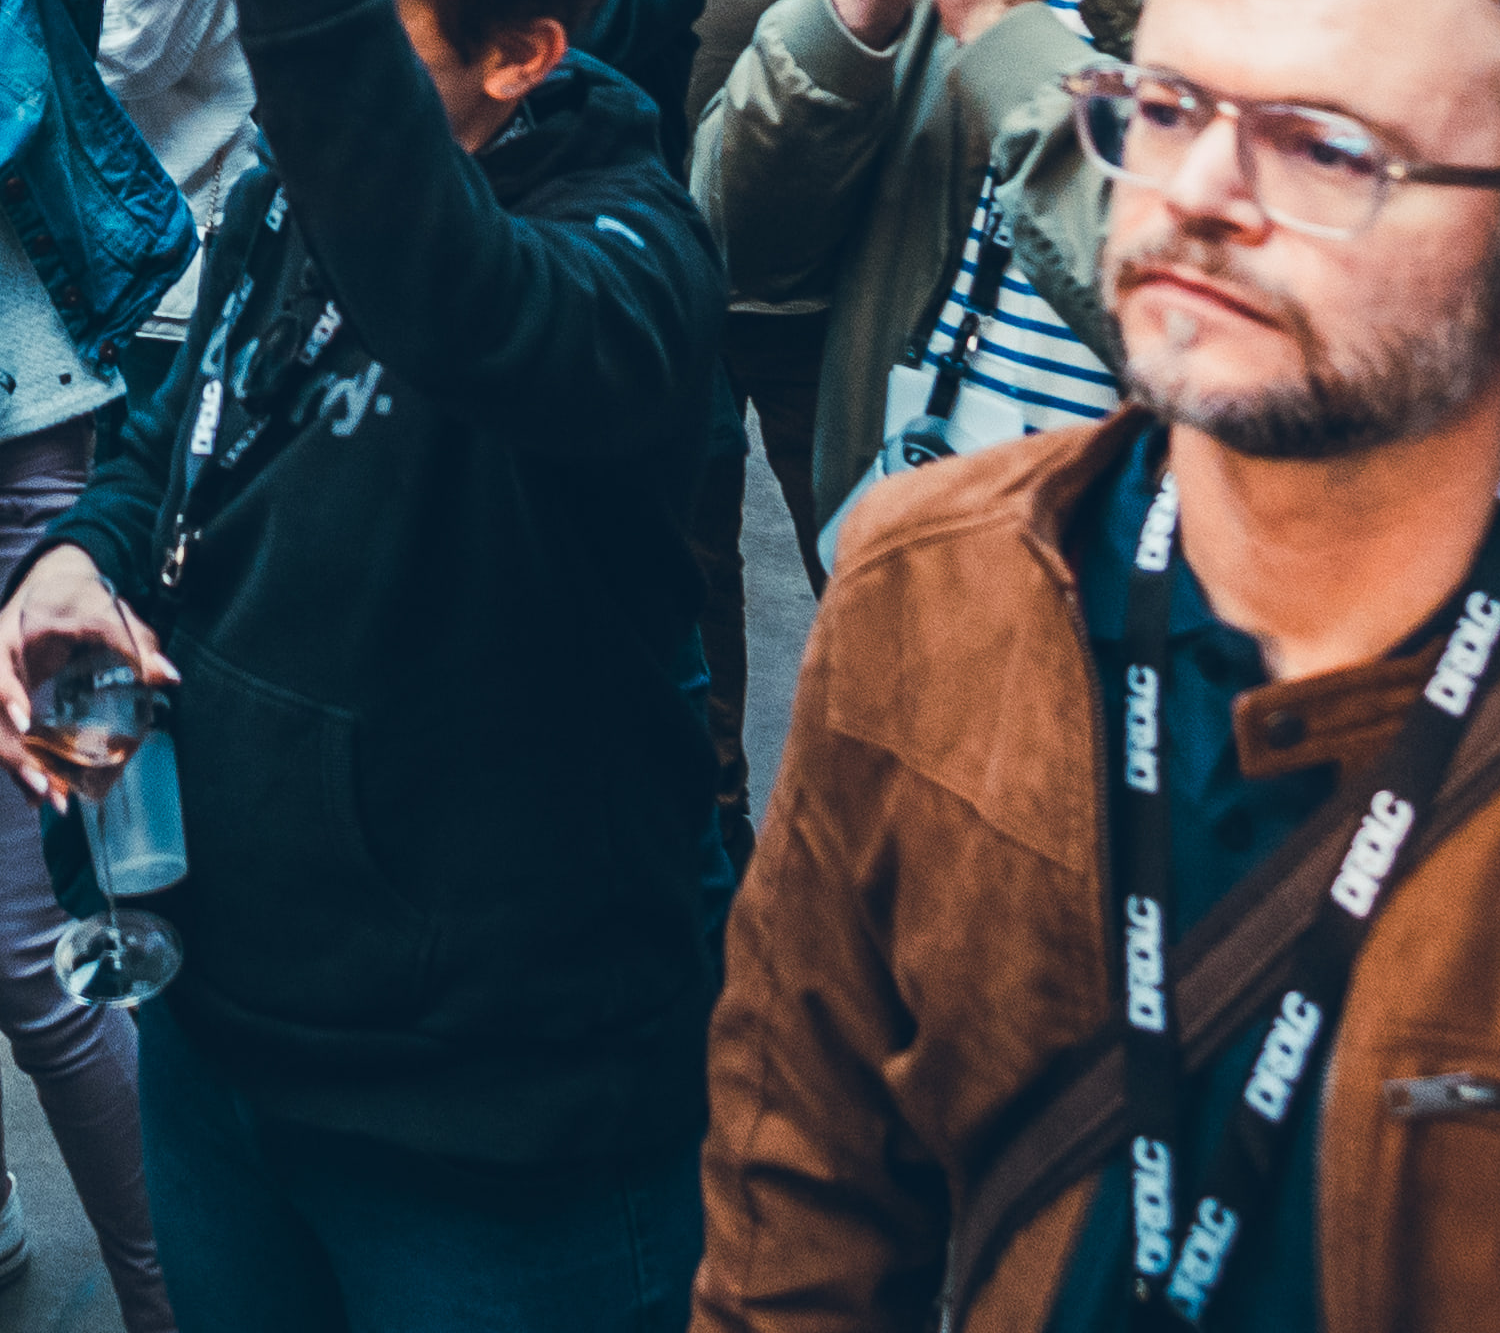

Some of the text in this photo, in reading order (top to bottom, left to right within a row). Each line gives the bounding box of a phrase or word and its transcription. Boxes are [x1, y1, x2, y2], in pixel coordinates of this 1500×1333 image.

[191, 379, 223, 456] DRDLC
[1125, 664, 1159, 793] DRDLC
[1330, 789, 1414, 919] DRDLC
[1125, 894, 1166, 1033] DRDLC
[1243, 990, 1323, 1123] DRDLC
[1132, 1135, 1174, 1276] DRDLC
